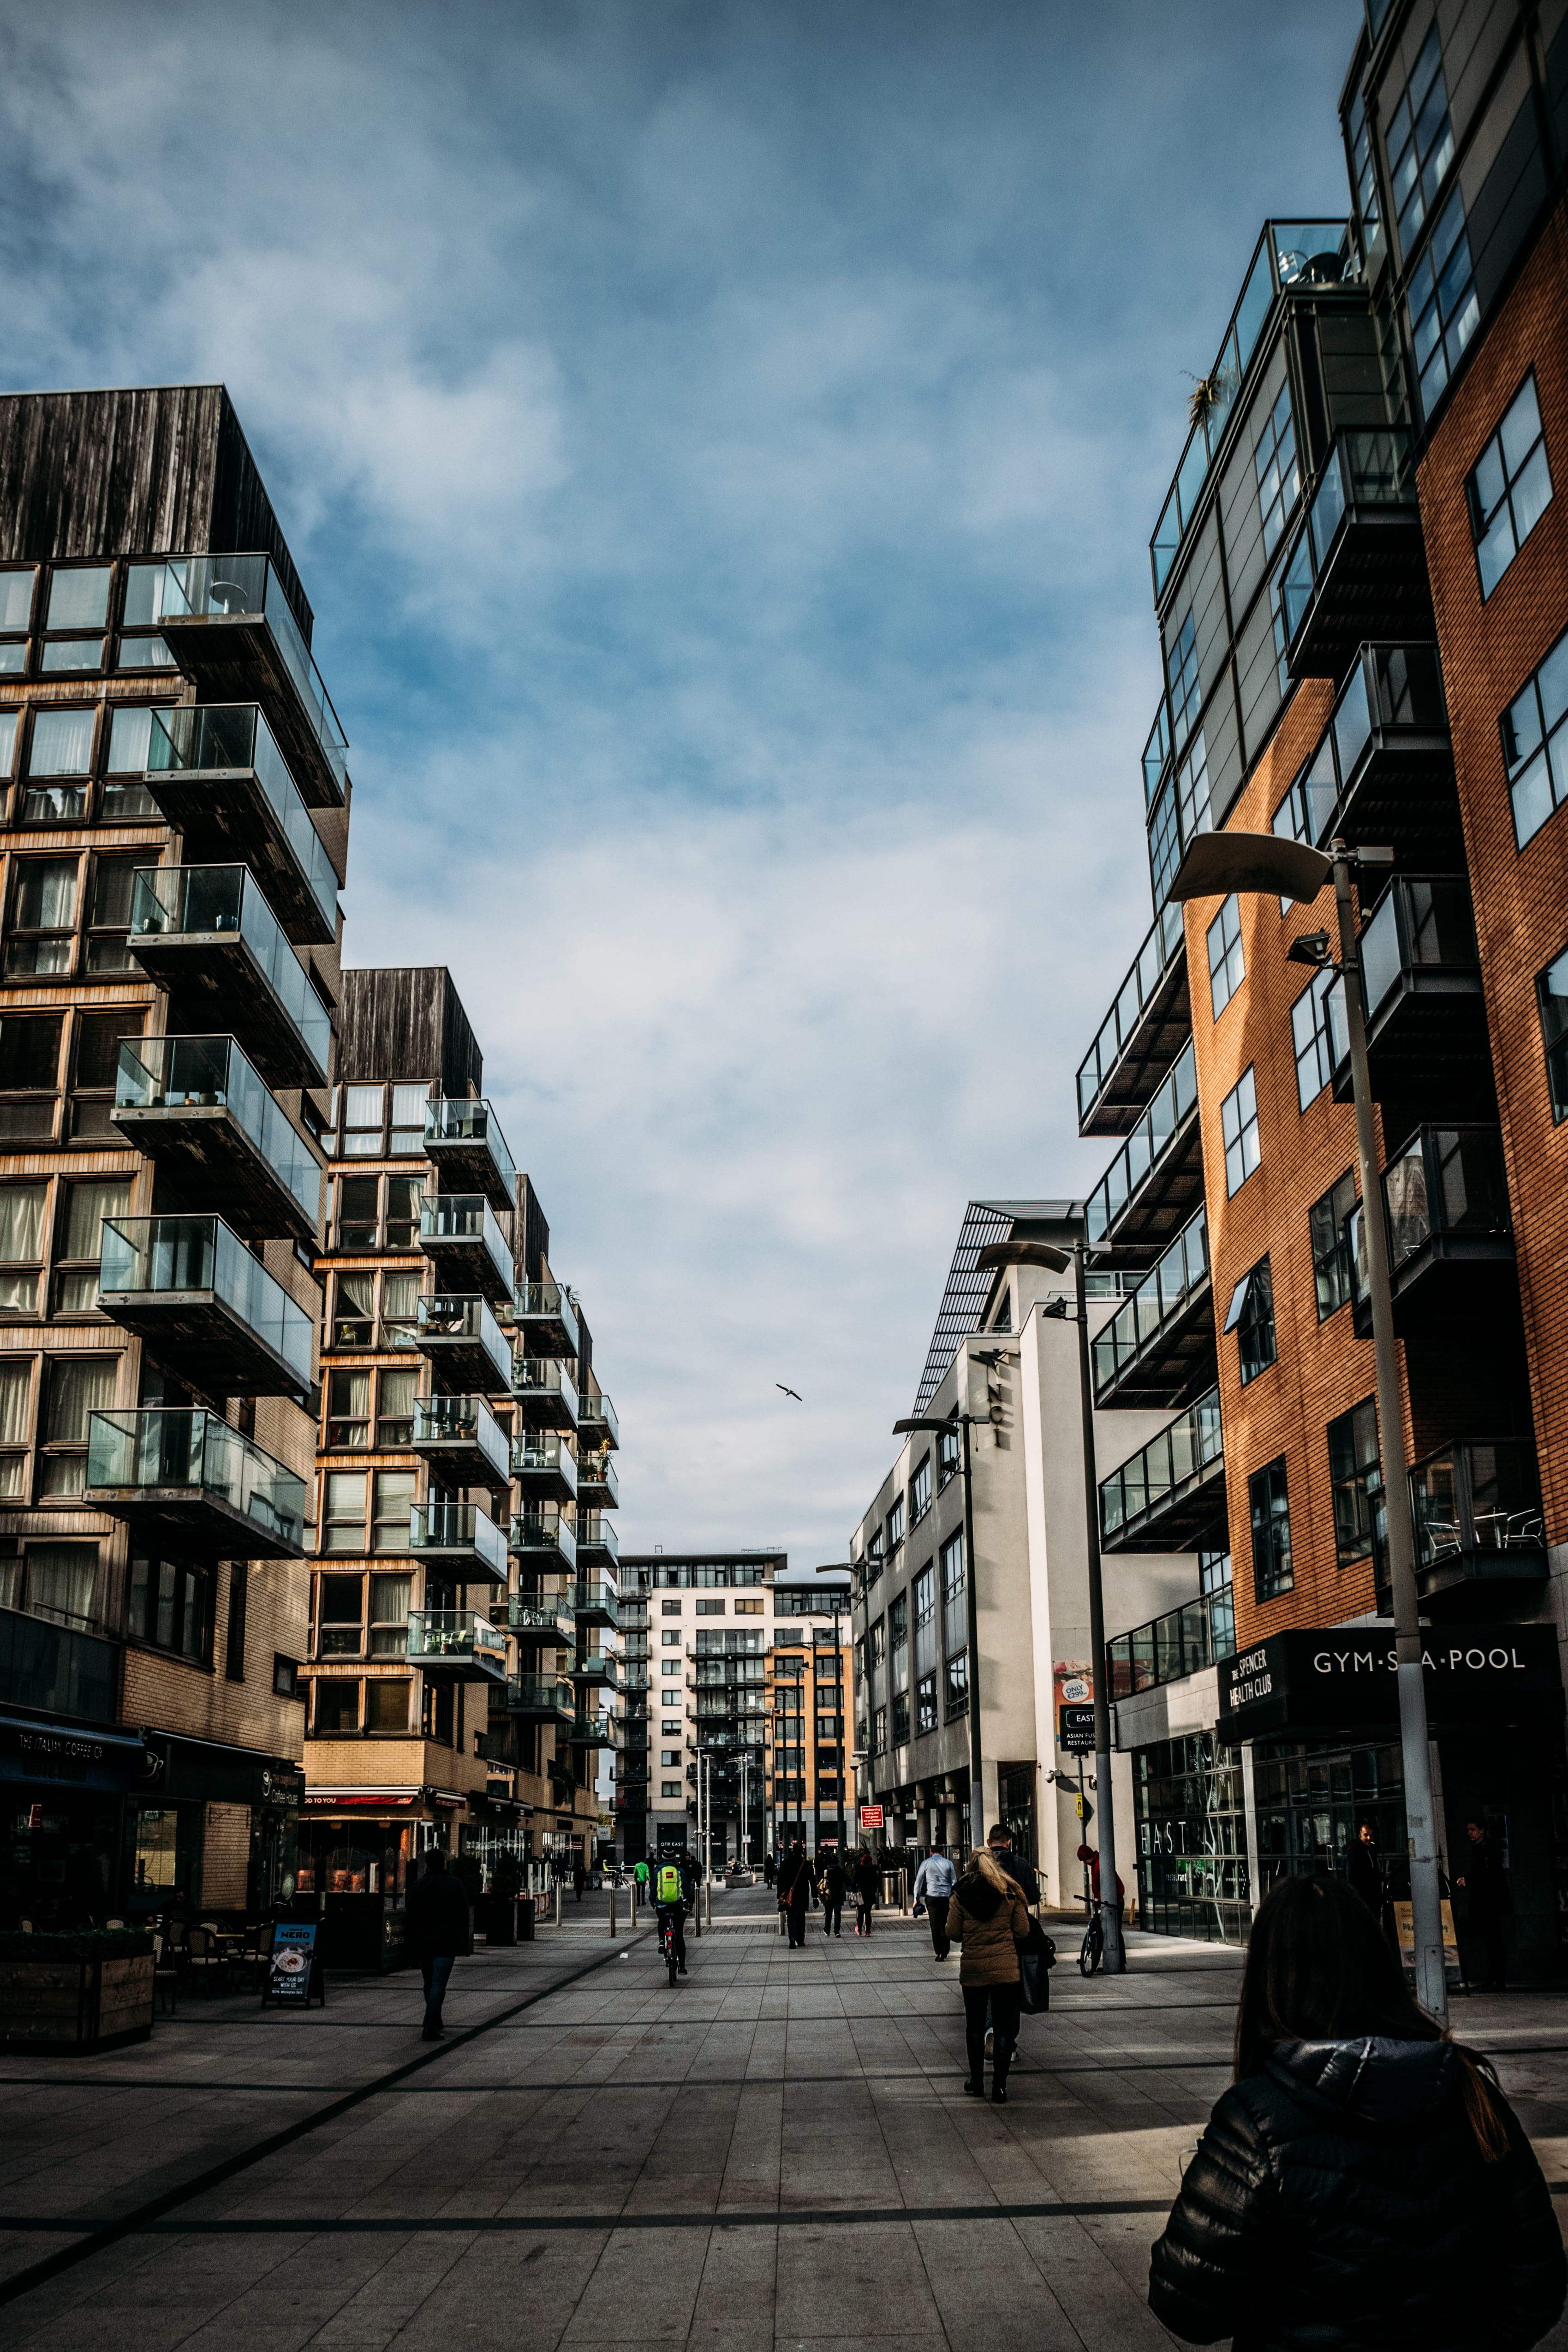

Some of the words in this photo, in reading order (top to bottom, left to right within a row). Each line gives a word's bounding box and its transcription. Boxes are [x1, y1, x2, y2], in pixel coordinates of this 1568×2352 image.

[1239, 1649, 1267, 1677] SPENCER
[1314, 1652, 1373, 1673] GYM
[1387, 1651, 1436, 1671] SA
[1449, 1649, 1525, 1669] POOL
[1066, 1684, 1083, 1694] ONLY
[1229, 1681, 1253, 1707] HEALTH
[1254, 1674, 1272, 1697] CLUB
[19, 1734, 32, 1749] THE
[34, 1737, 63, 1752] ITALIAN
[65, 1742, 91, 1757] COFFEE
[271, 1789, 286, 1804] Coffee
[286, 1791, 298, 1805] House
[1141, 1822, 1186, 1854] EAST
